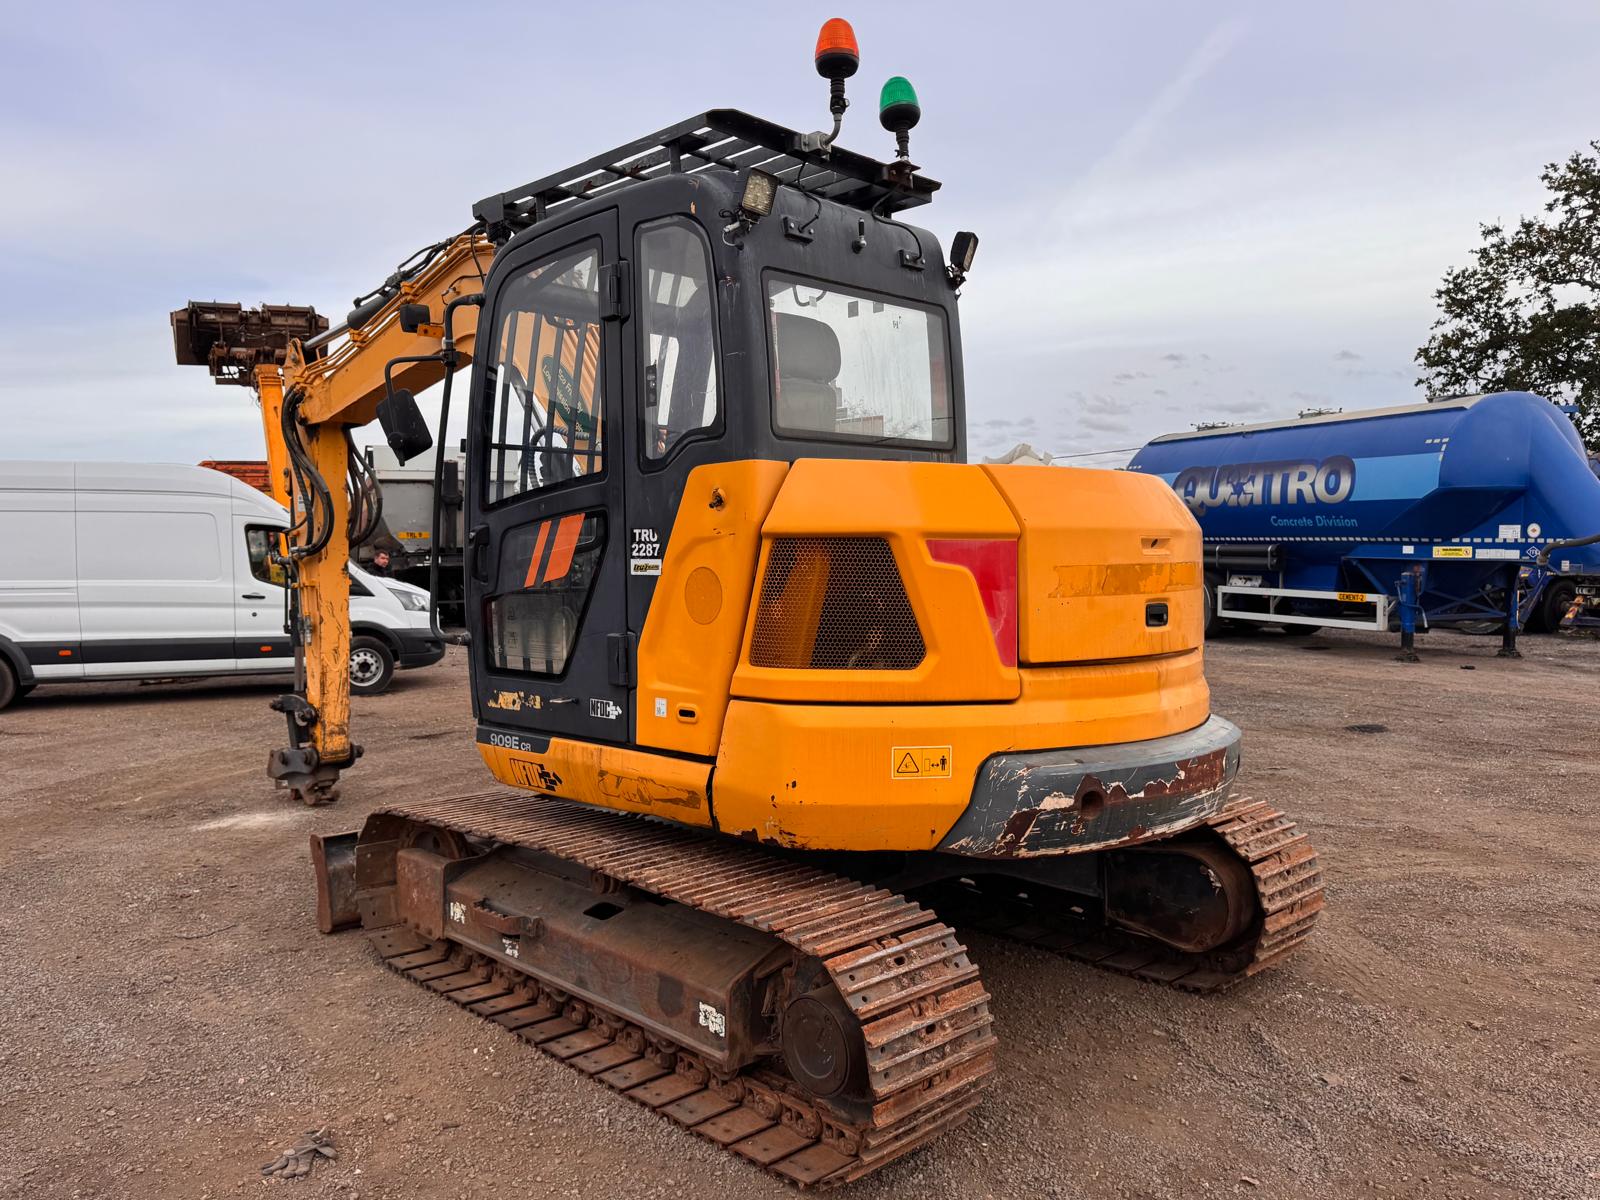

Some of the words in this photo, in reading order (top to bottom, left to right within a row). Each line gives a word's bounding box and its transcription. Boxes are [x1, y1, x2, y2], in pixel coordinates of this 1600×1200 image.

[1270, 515, 1313, 527] Concrete
[1315, 515, 1359, 528] Division
[633, 528, 658, 542] TRU
[631, 543, 660, 557] 2287
[590, 698, 613, 719] NFDC
[490, 733, 520, 749] 909E
[510, 758, 546, 789] NFDC
